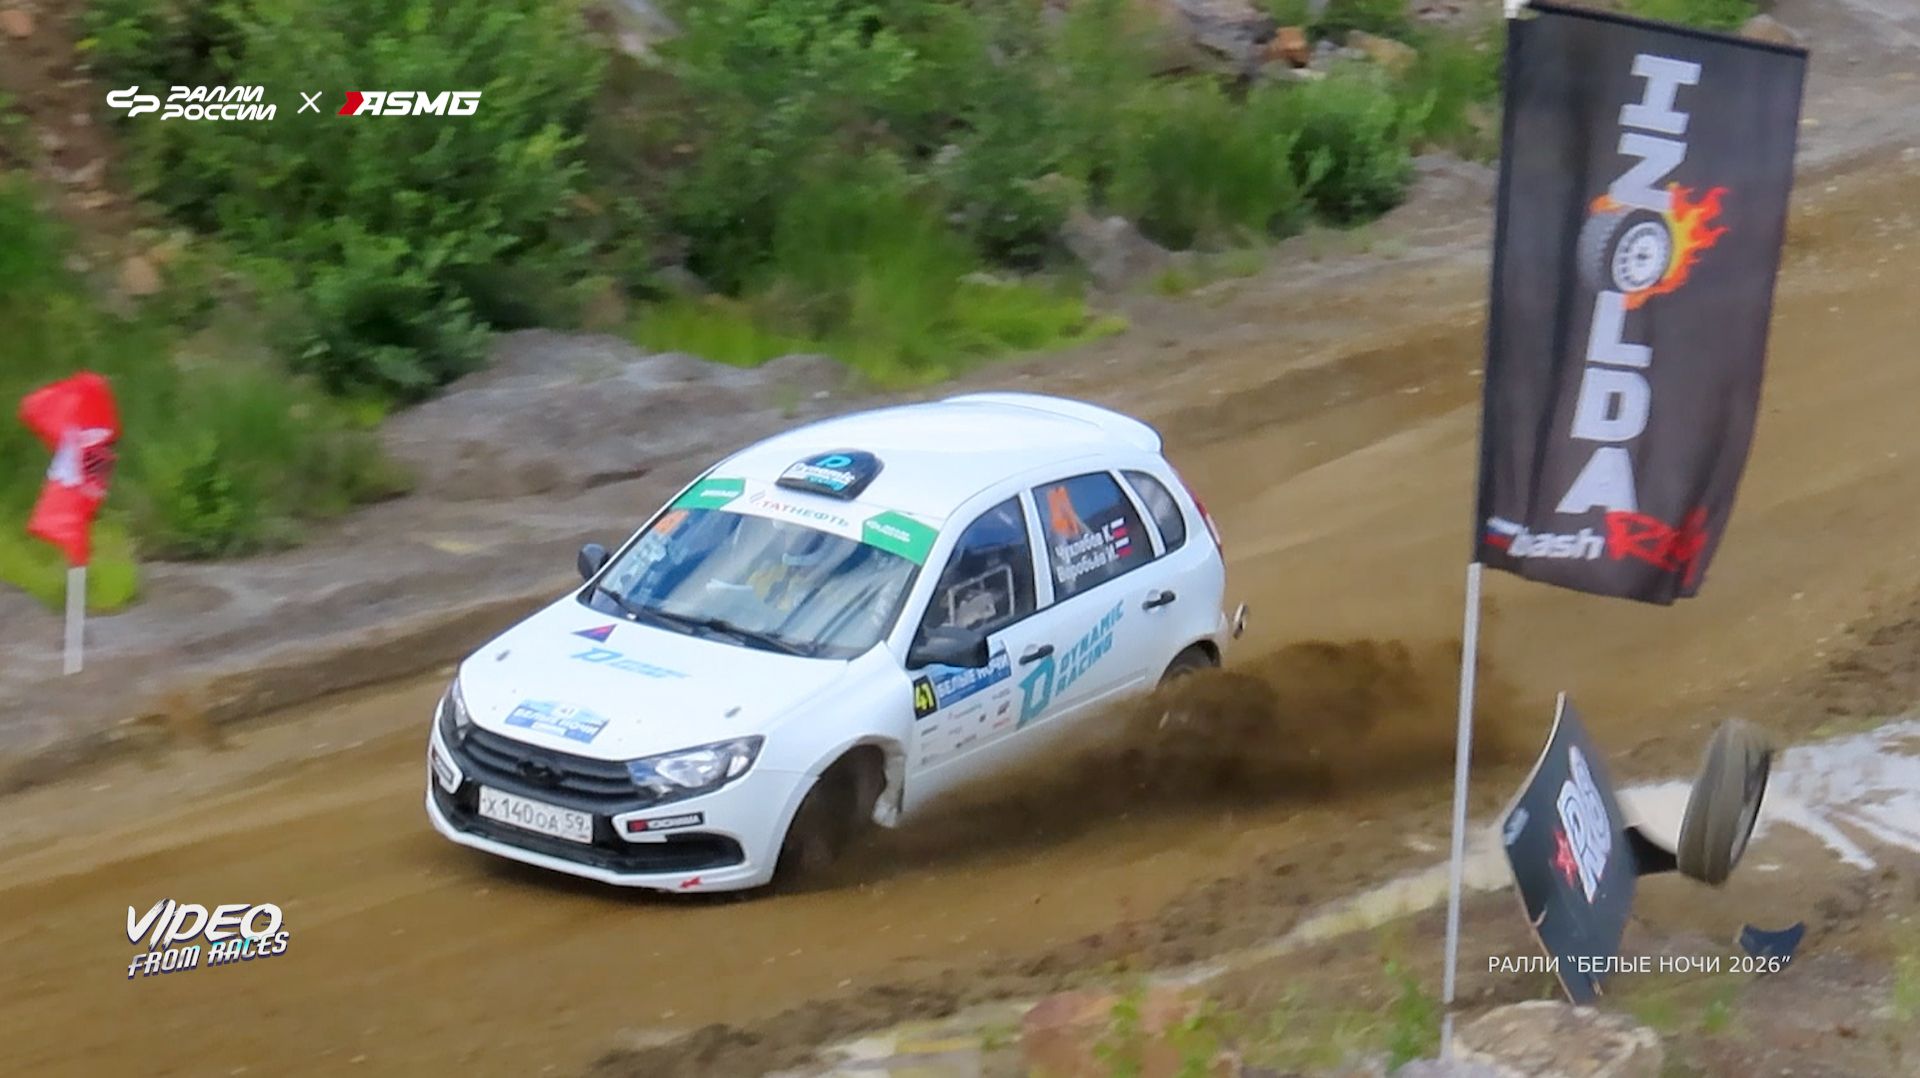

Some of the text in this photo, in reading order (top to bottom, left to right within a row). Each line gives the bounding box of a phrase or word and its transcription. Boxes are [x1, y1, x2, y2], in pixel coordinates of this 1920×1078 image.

[762, 500, 849, 527] ТАТНЕФТЬ
[1060, 598, 1124, 674] DYNAMIC
[1055, 630, 1113, 697] RACING
[915, 681, 935, 710] 41
[565, 813, 585, 832] 59
